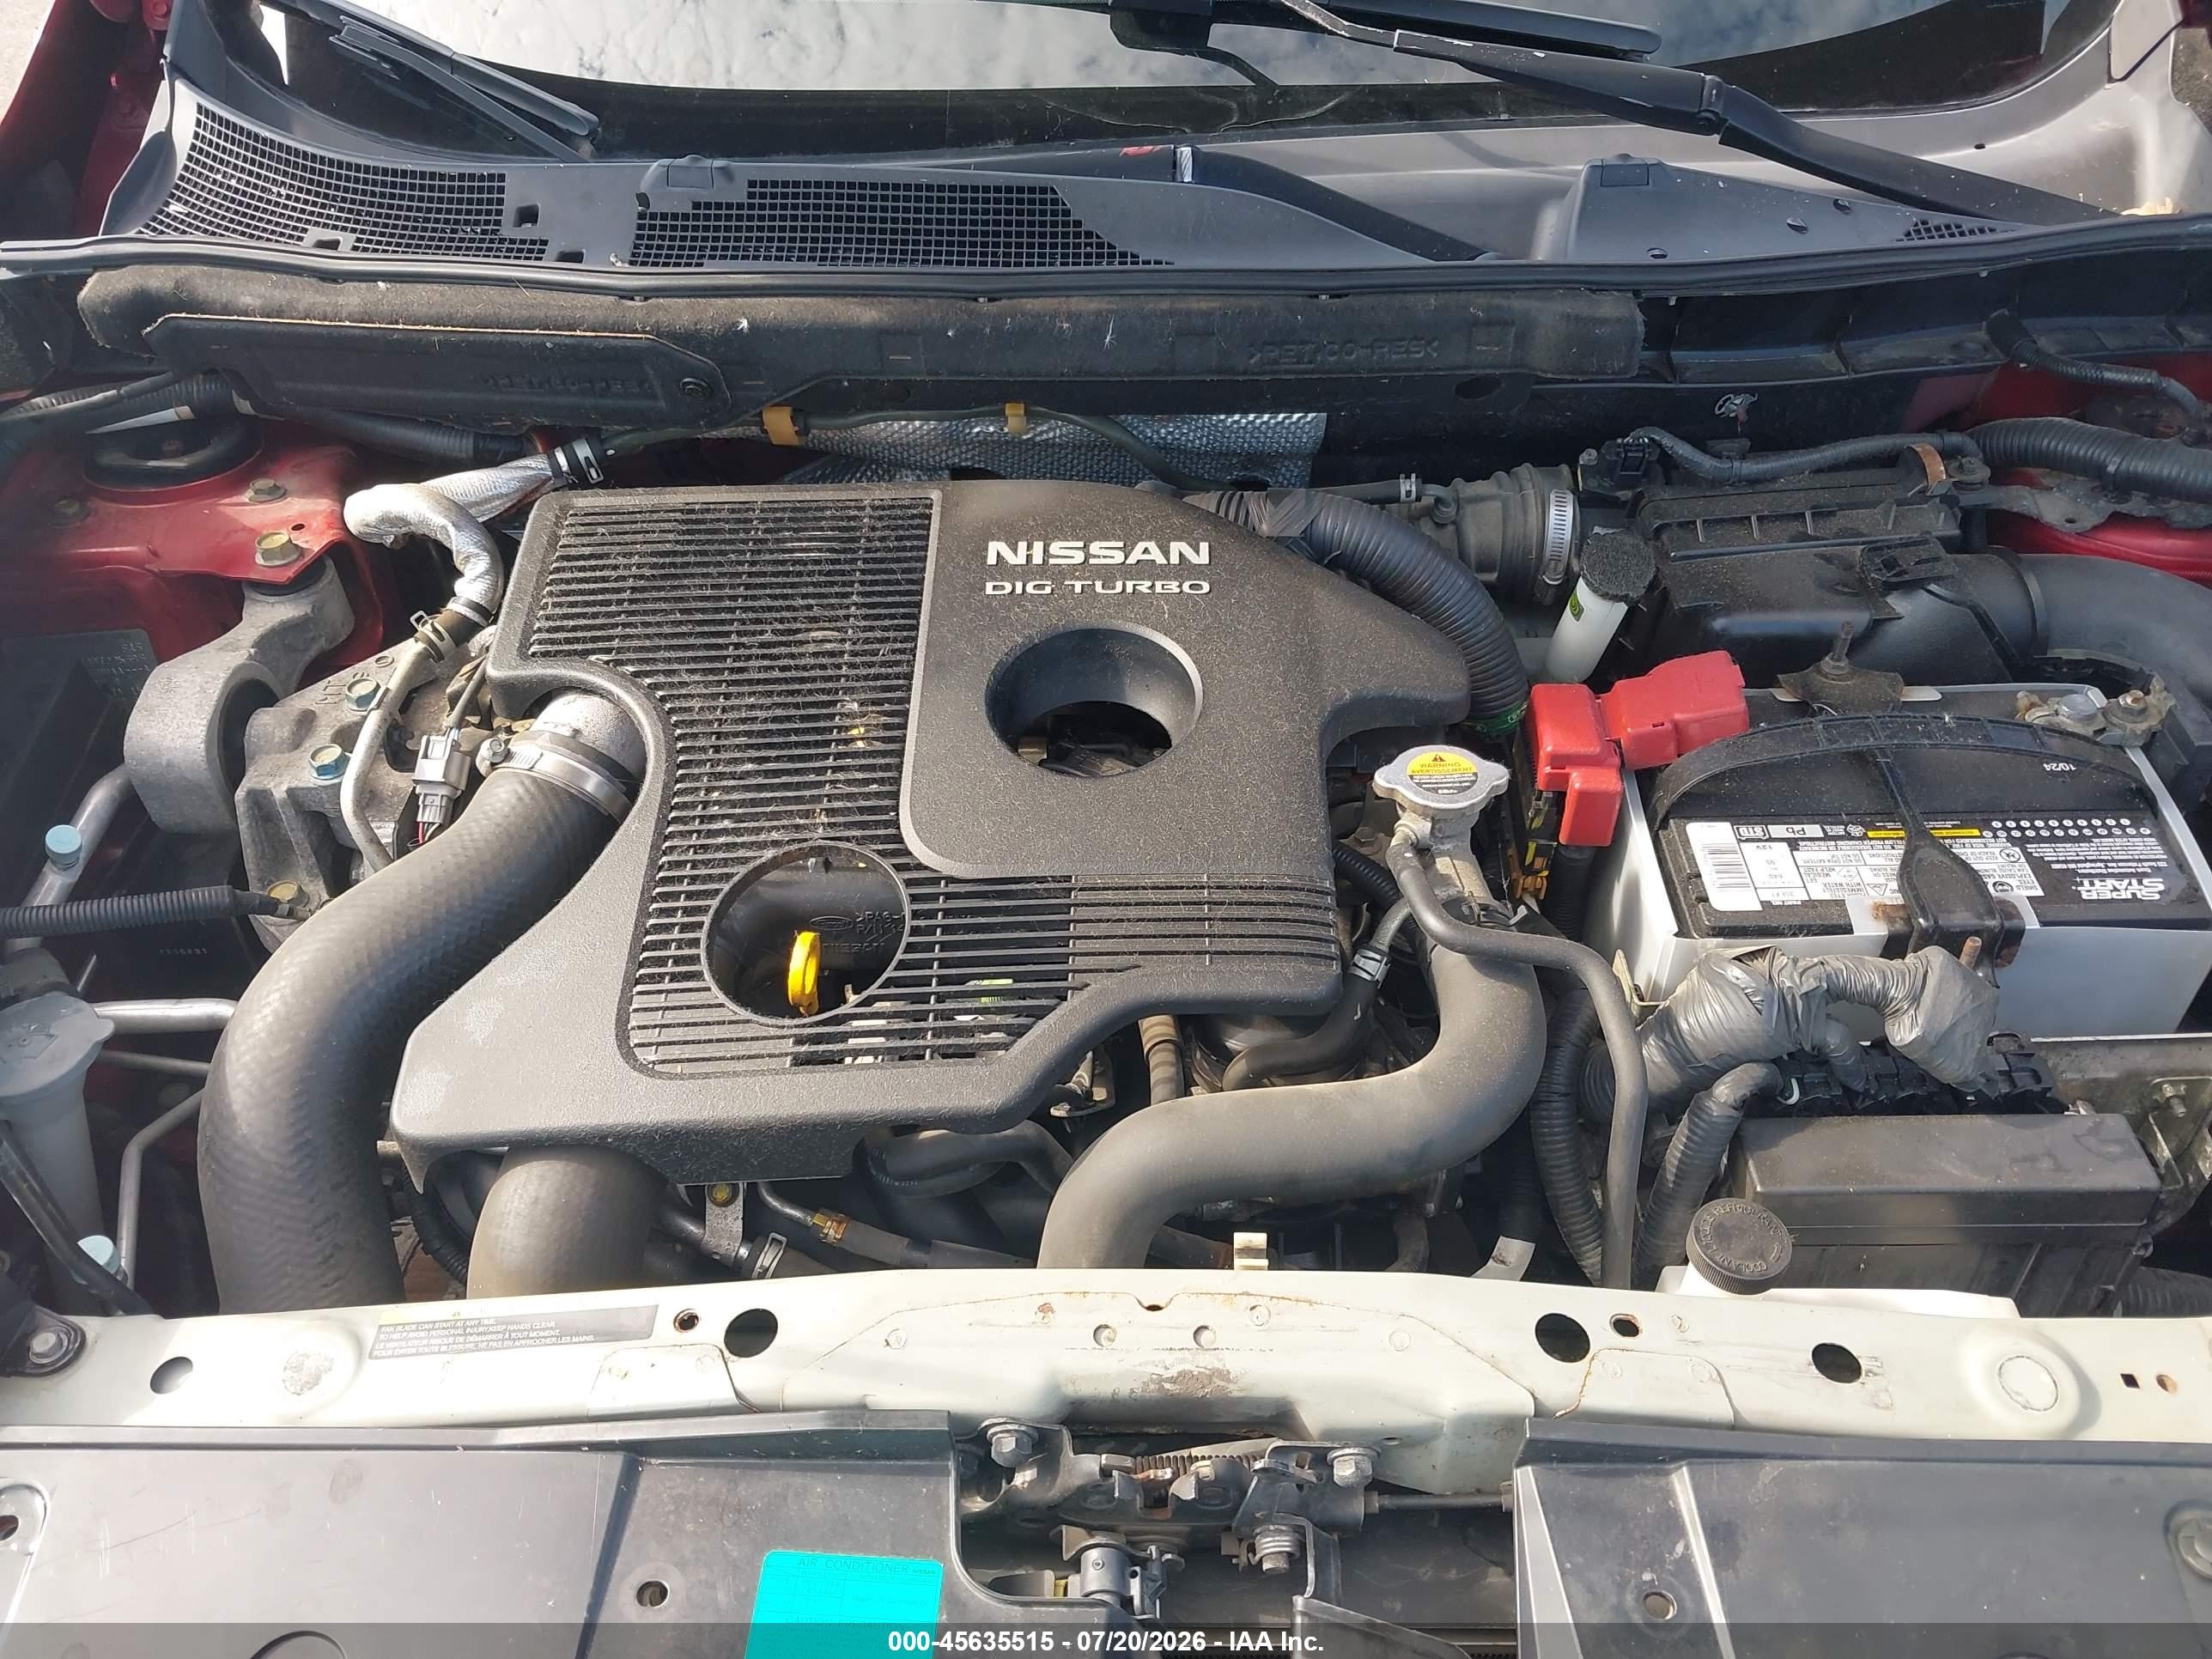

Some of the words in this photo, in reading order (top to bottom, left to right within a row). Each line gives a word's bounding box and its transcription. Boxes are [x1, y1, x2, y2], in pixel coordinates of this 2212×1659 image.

[987, 541, 1210, 566] NISSAN
[985, 581, 1054, 595] DIG
[1064, 580, 1211, 595] TURBO
[2042, 763, 2077, 772] 10/24
[1785, 827, 1807, 836] Pb
[2076, 878, 2165, 891] START
[2080, 889, 2161, 900] SUPER
[380, 1325, 395, 1334] FAN
[395, 1324, 417, 1333] BLADE
[418, 1322, 434, 1331] CAN
[434, 1322, 455, 1330] START
[388, 1332, 406, 1340] HELP
[405, 1330, 428, 1339] AVOID
[428, 1328, 465, 1338] PERSONAL
[386, 1338, 428, 1348] VENTILATEUR
[428, 1336, 455, 1346] RISQUE
[466, 1333, 504, 1343] DÉMARRER
[504, 1331, 511, 1340] À
[373, 1349, 394, 1358] POUR
[418, 1345, 441, 1354] TOUTE
[489, 1340, 503, 1349] PAS
[513, 1337, 558, 1347] APPROCHER
[797, 1557, 818, 1567] AIR
[823, 1559, 909, 1573] CONDITIONER
